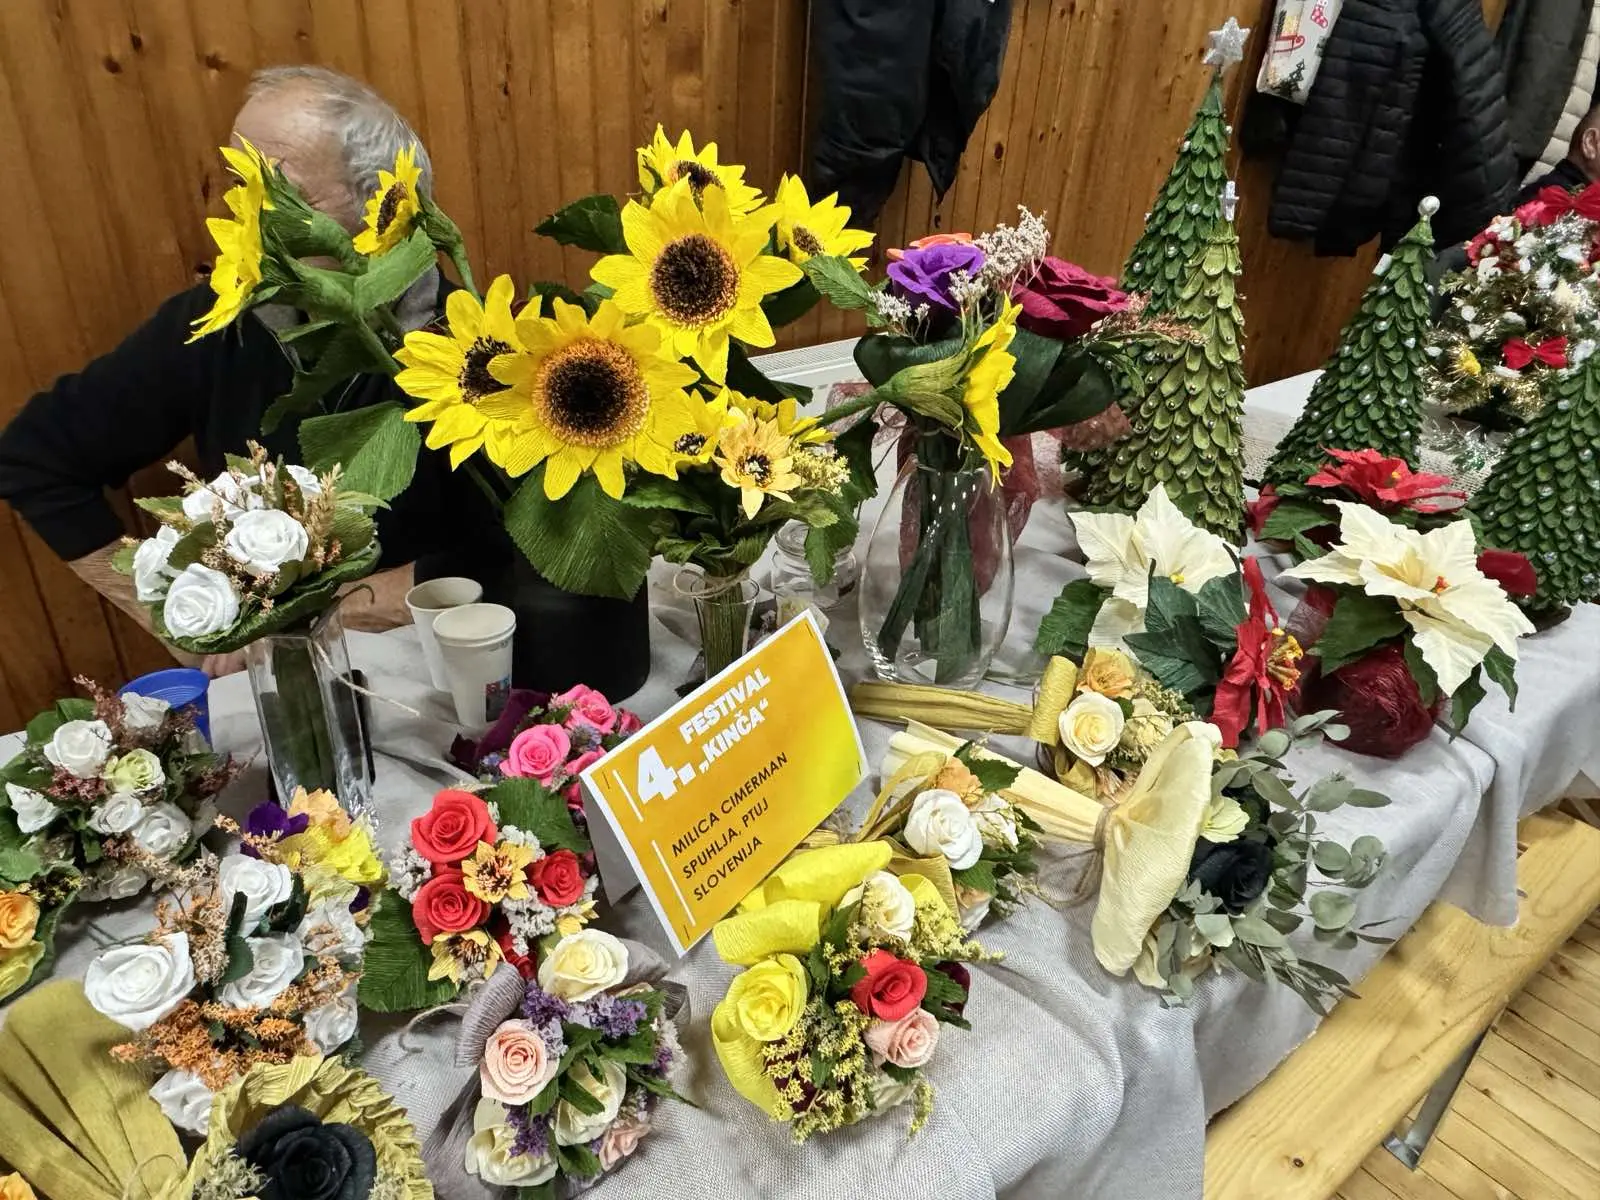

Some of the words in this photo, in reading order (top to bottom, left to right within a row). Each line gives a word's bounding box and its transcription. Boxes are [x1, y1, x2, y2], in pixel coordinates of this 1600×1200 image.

[679, 667, 771, 745] FESTIVAL
[636, 745, 696, 805] 4.
[671, 812, 721, 857] MILICA
[721, 751, 789, 815] CIMERMAN
[682, 822, 742, 879] SPUHLJA,
[741, 797, 770, 831] PTUJ
[693, 837, 763, 901] SLOVENIJA
